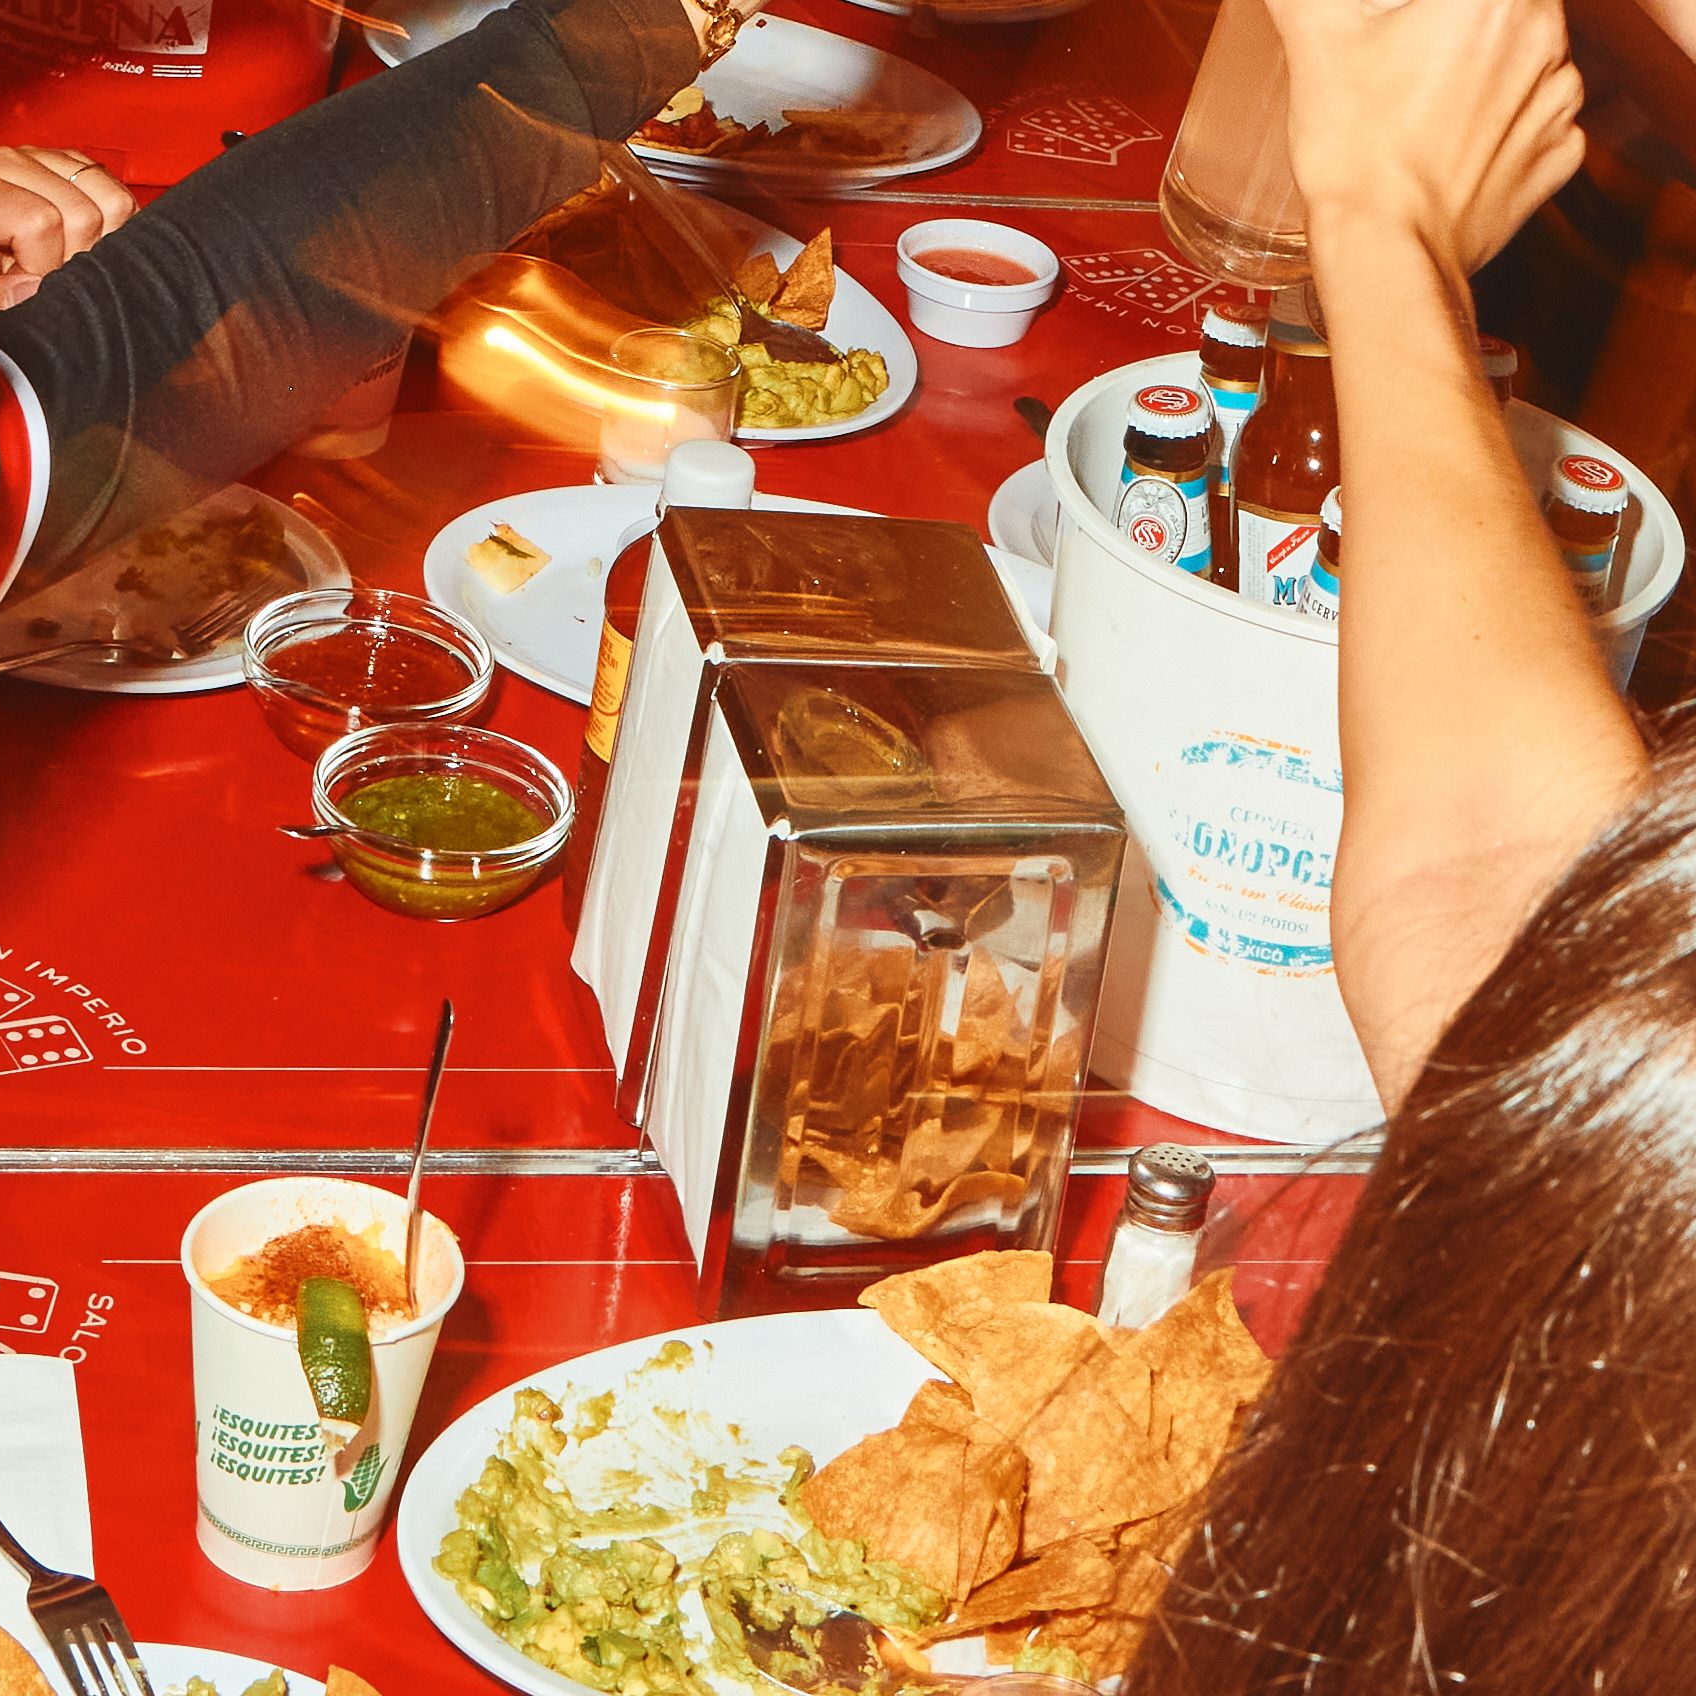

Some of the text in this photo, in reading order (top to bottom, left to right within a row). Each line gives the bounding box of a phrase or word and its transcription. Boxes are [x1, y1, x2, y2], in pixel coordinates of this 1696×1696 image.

[23, 960, 148, 1057] IMPERIO
[213, 1404, 322, 1441] ¡ESQUITES
[211, 1426, 326, 1464] ¡ESQUITES!
[210, 1448, 327, 1485] ¡ESQUITES!
